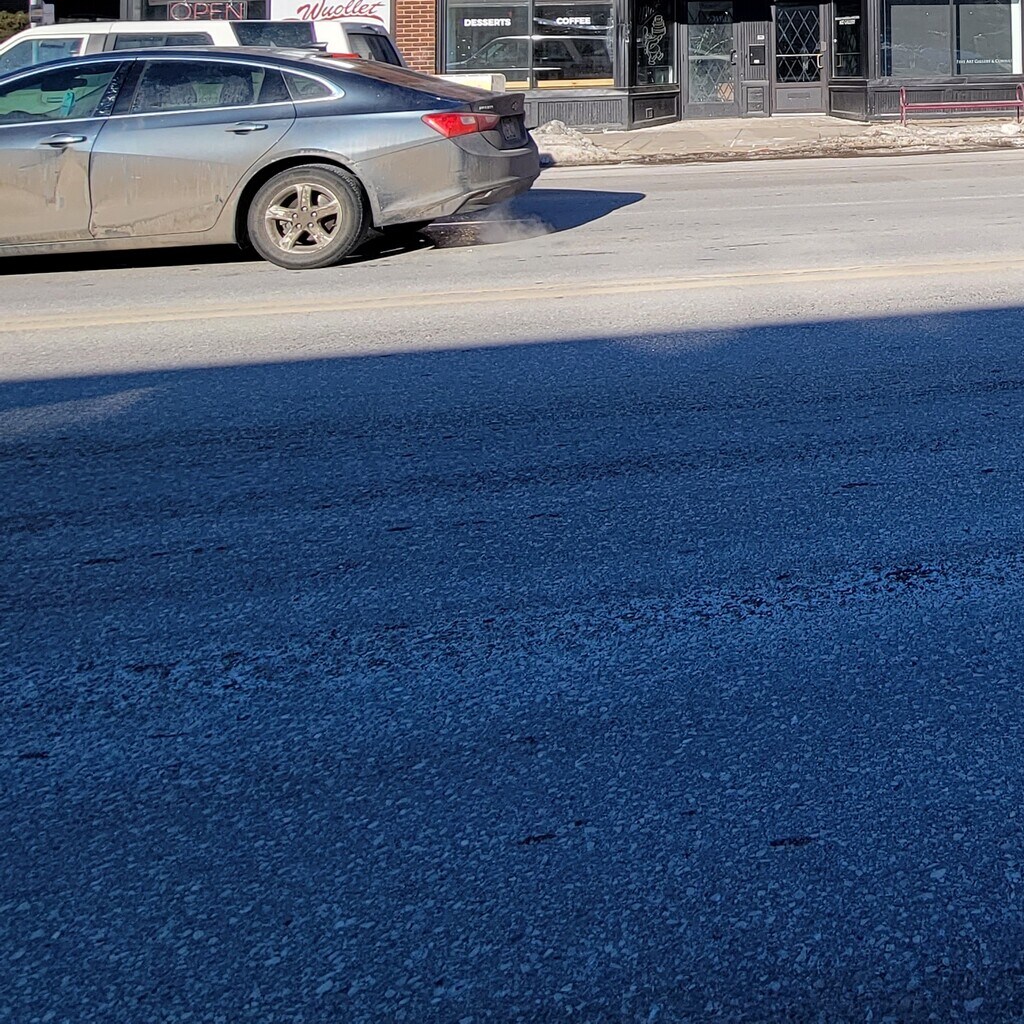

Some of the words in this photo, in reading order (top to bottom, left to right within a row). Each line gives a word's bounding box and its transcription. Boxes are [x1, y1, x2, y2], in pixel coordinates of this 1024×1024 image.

[170, 2, 243, 21] OPEN
[464, 18, 511, 27] DESSERTS
[556, 17, 591, 25] COFFEE
